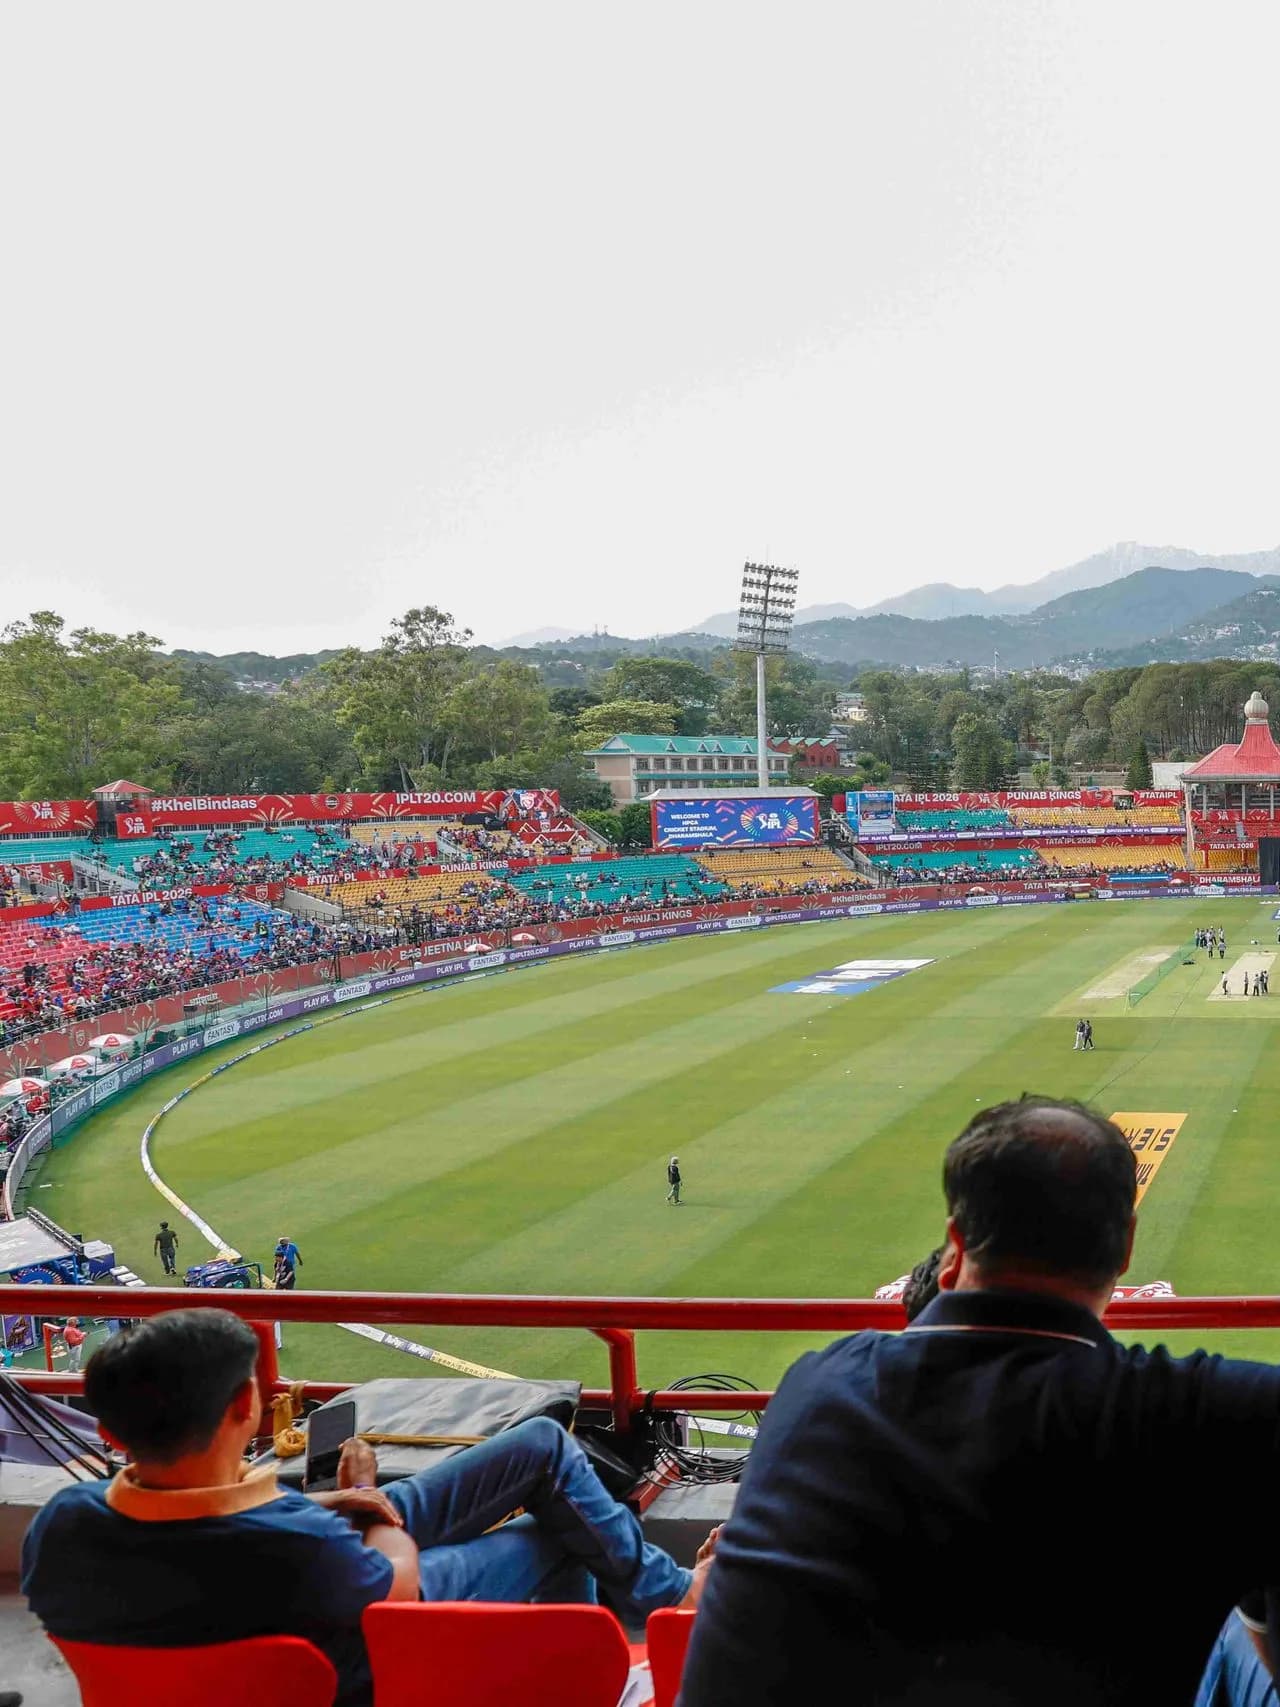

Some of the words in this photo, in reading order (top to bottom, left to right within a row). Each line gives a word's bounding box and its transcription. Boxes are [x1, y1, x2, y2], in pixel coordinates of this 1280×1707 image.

[396, 792, 476, 805] IPLT20.COM
[894, 793, 912, 803] ATA
[914, 793, 931, 803] IPL
[933, 793, 960, 803] 2026
[1007, 792, 1047, 801] PUNJAB
[1049, 791, 1082, 800] KINGS
[1140, 791, 1178, 799] #TATAIPL
[151, 797, 258, 812] #KhelBindaas
[41, 811, 55, 820] IPL
[133, 824, 147, 834] IPL
[767, 820, 783, 830] IPL
[440, 862, 478, 873] PUNJAB
[479, 860, 509, 871] KINGS
[307, 872, 358, 886] #TATAPL
[110, 892, 140, 908] TATA
[142, 890, 162, 904] IPL
[162, 886, 194, 901] 2026
[662, 909, 693, 922] KINGS
[423, 940, 461, 957] JEETNA
